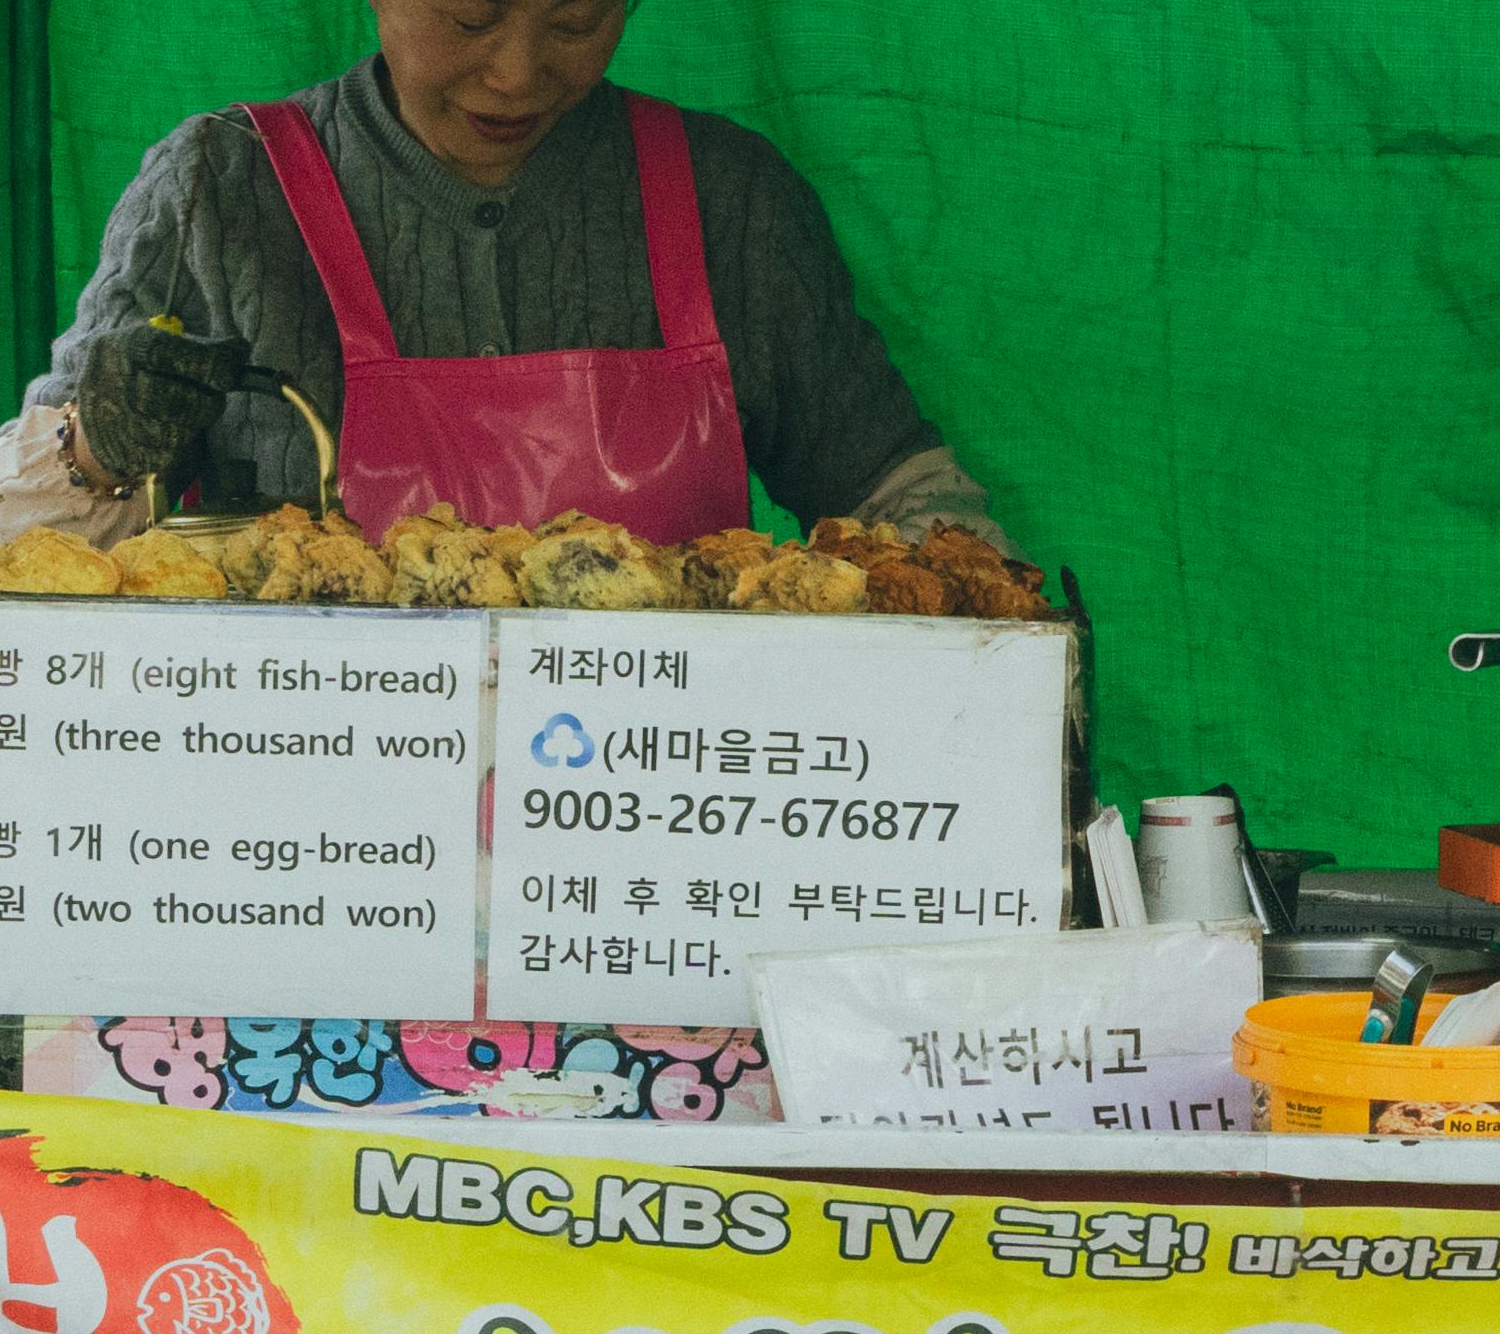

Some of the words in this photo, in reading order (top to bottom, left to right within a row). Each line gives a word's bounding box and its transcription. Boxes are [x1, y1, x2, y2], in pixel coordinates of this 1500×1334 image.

[46, 651, 104, 690] 8개
[131, 656, 237, 698] (eight
[257, 660, 459, 701] fish-bread)
[528, 645, 690, 690] 계좌이체
[53, 719, 162, 757] (three
[182, 722, 355, 758] thousand
[376, 728, 468, 764] won)
[602, 727, 870, 781] (새마을금고)
[522, 788, 960, 843] 9003-267-676877
[46, 823, 102, 862] 1개
[129, 829, 211, 867] (one
[231, 832, 438, 871] egg-bread)
[52, 889, 132, 928] (two
[153, 892, 326, 927] thousand
[346, 897, 437, 935] won)
[521, 874, 598, 916] 이체
[623, 877, 662, 917] 후
[684, 878, 762, 920] 확인
[788, 882, 1038, 928] 부탁드립니다.
[519, 934, 731, 978] 감사합니다.
[901, 1025, 1148, 1089] 계산하시고
[1449, 1119, 1472, 1133] No
[355, 1148, 790, 1256] MBC,KBS
[825, 1199, 953, 1264] TV
[989, 1206, 1208, 1280] 극찬!
